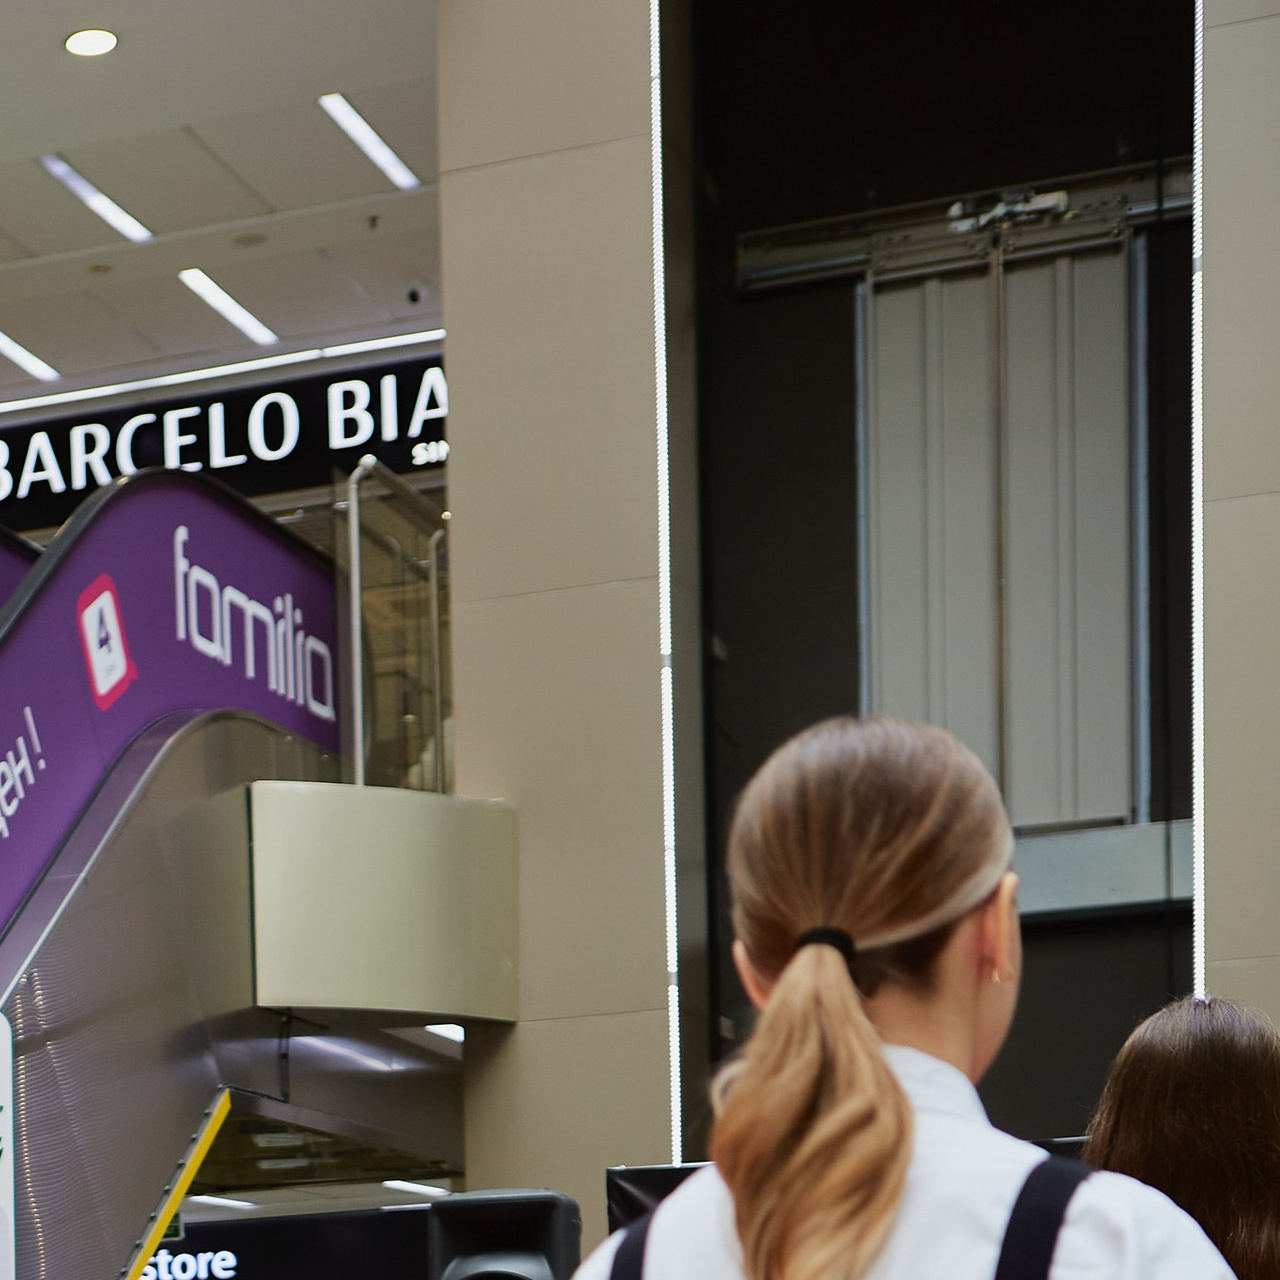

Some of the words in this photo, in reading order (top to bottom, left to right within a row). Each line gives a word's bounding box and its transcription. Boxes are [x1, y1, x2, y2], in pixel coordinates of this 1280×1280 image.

[327, 366, 449, 450] BIA
[98, 606, 112, 654] 4
[174, 525, 335, 722] familia
